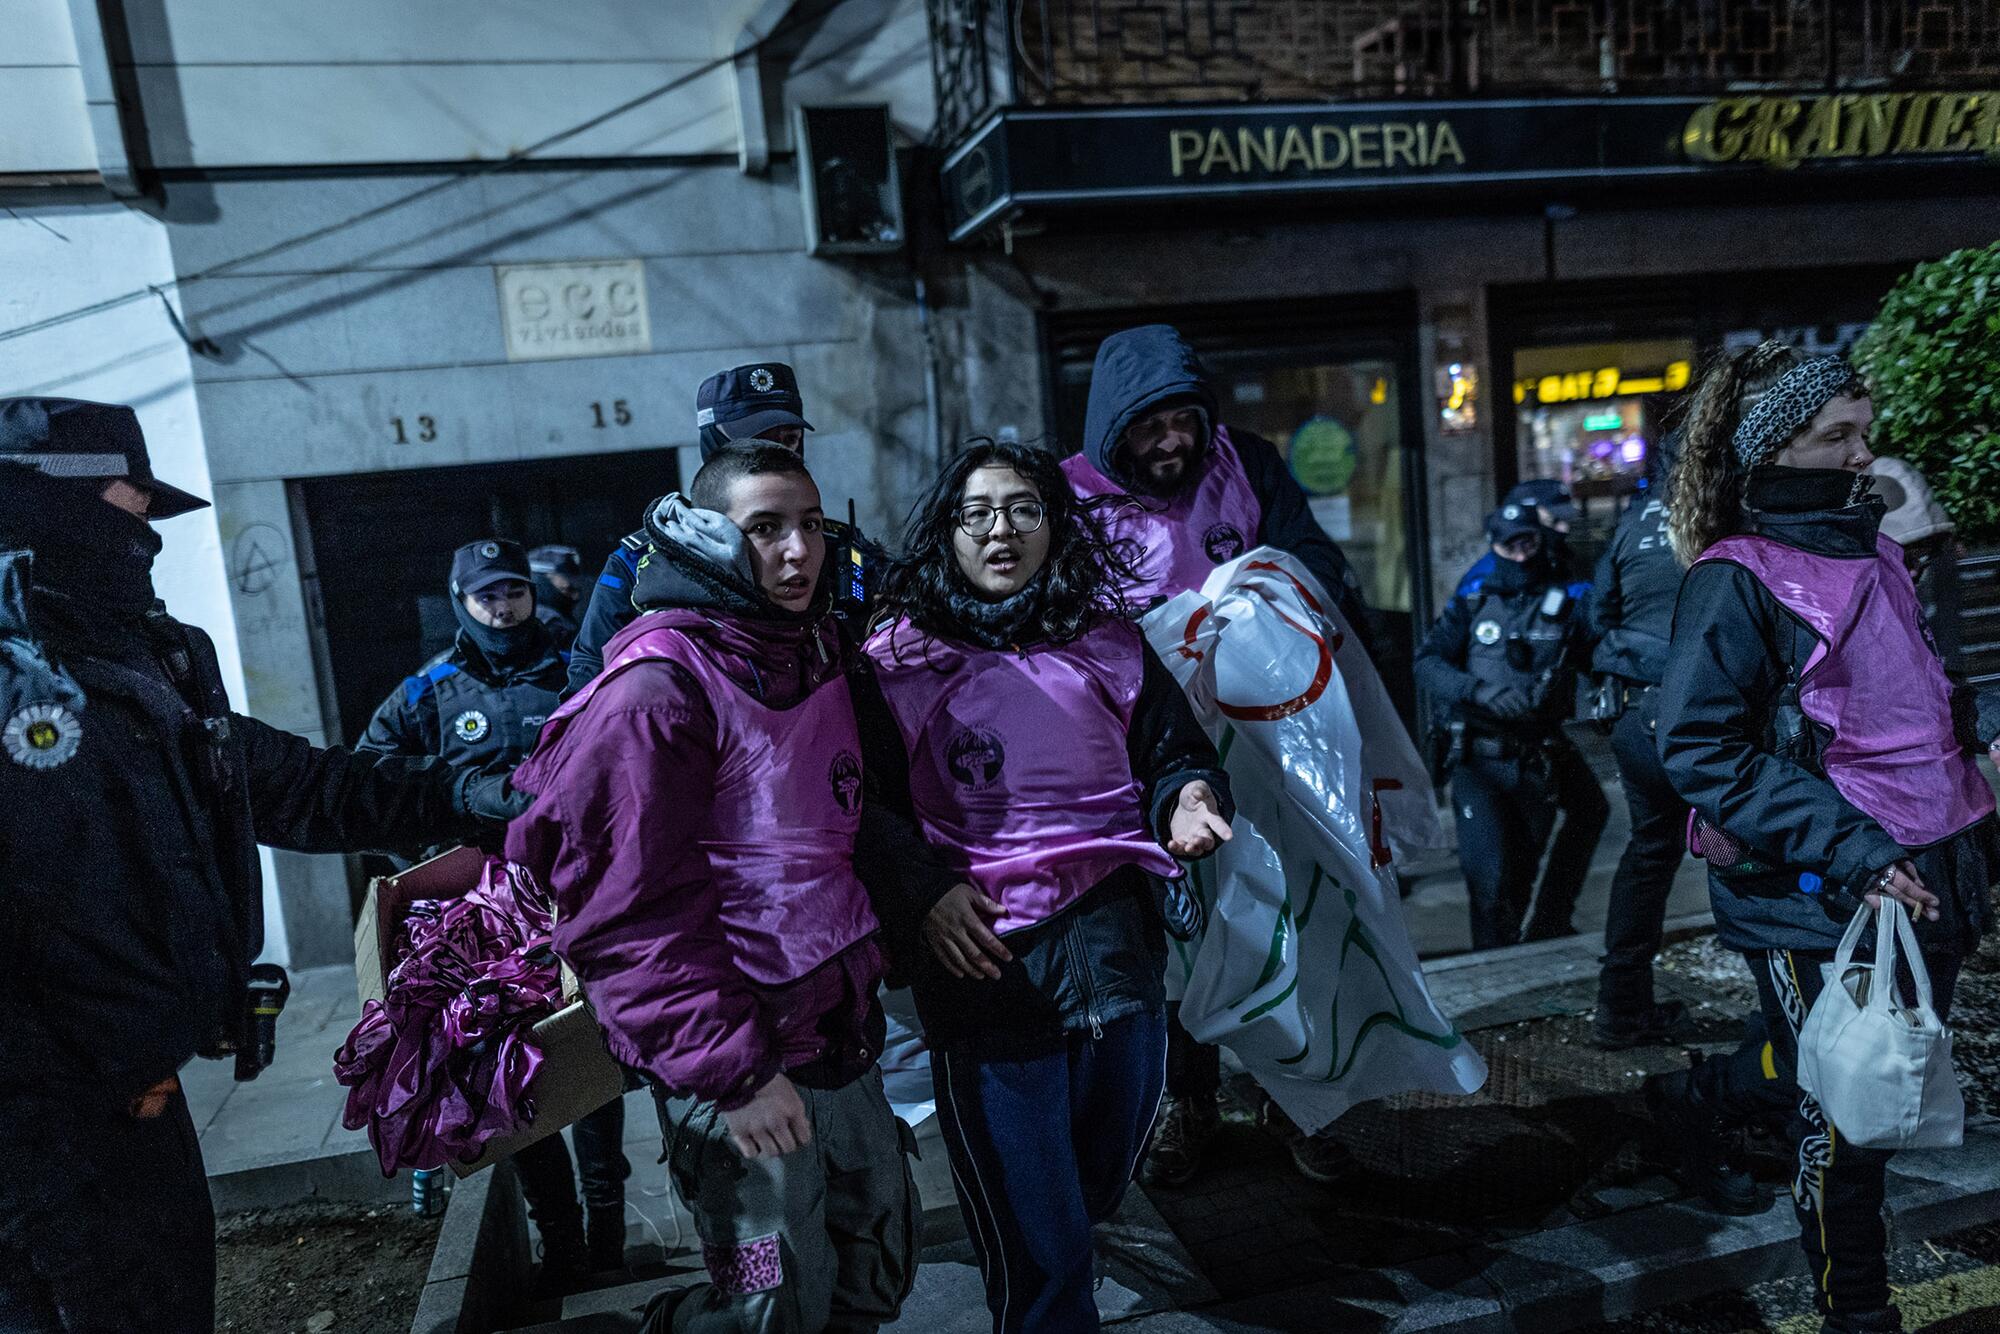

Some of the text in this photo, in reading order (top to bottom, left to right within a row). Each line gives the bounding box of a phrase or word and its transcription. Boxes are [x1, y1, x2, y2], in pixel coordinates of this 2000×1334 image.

[1169, 120, 1466, 177] PANADERIA
[389, 414, 437, 445] 13
[590, 400, 632, 429] 15
